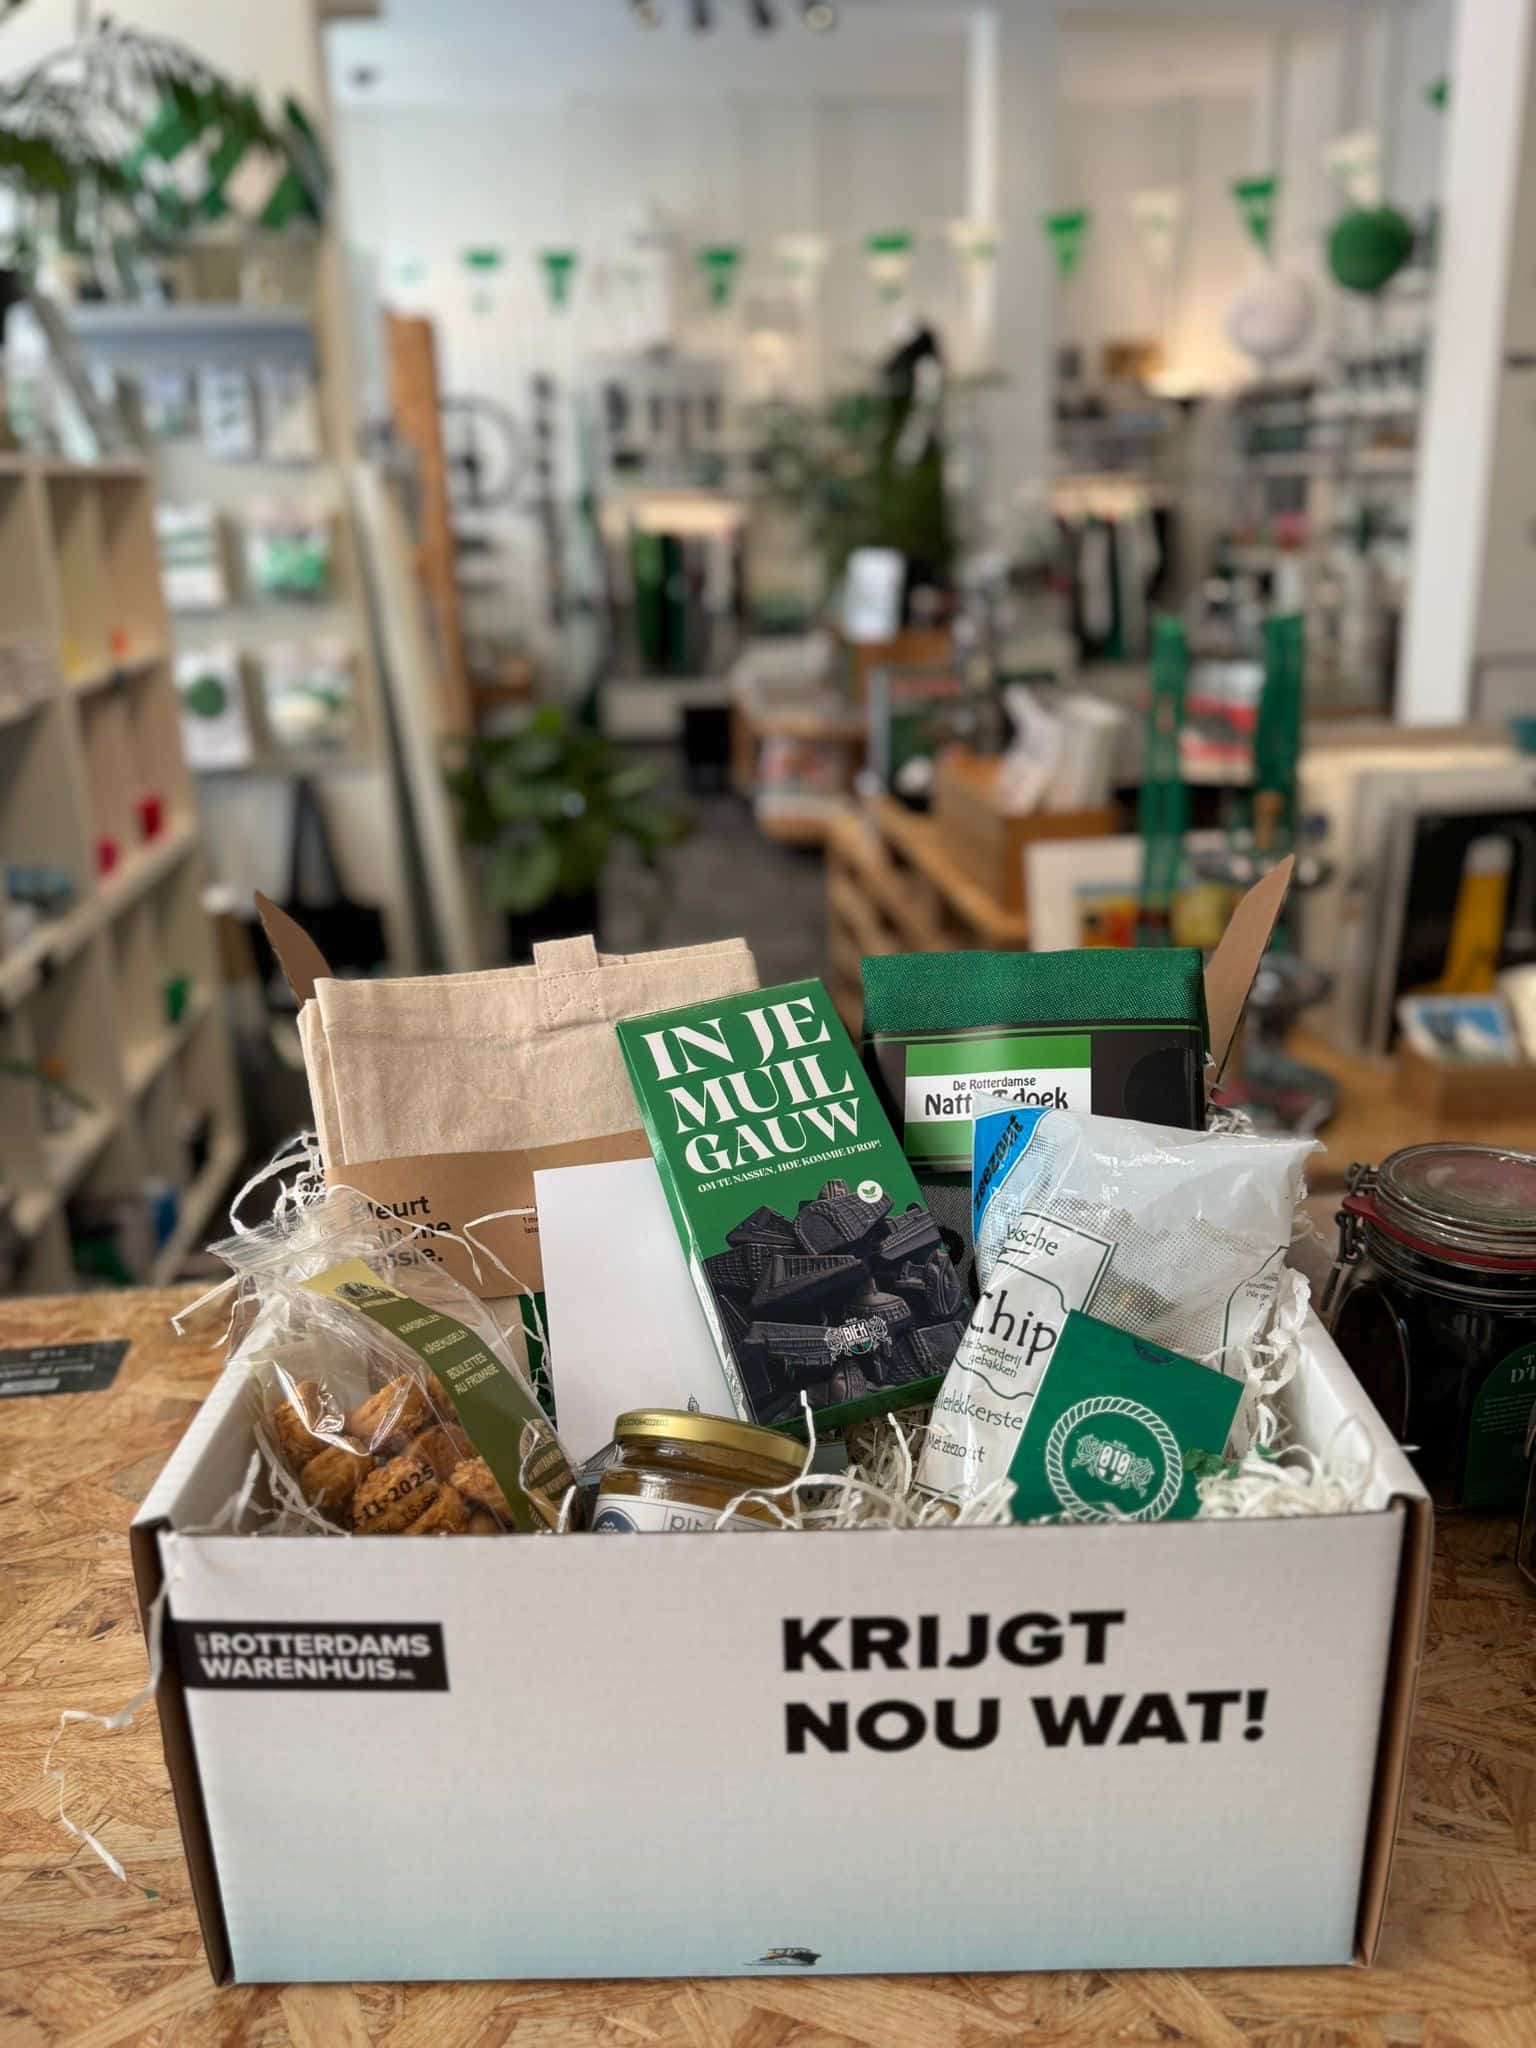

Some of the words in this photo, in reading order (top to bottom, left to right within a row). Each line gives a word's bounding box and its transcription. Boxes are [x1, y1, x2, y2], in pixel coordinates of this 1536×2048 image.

[640, 1018, 734, 1081] IN
[740, 997, 832, 1066] JE
[664, 1054, 855, 1134] MUIL
[953, 1080, 966, 1091] De
[969, 1077, 1036, 1090] Rotterdamse
[685, 1098, 860, 1174] GAUW
[697, 1180, 717, 1193] OM
[717, 1176, 732, 1188] TE
[733, 1166, 777, 1184] NASSEN,
[778, 1160, 801, 1173] HOE
[802, 1148, 847, 1167] KOMMIE
[970, 1290, 1057, 1367] Chip
[446, 1352, 488, 1381] BOULETTES
[207, 1632, 432, 1657] ROTTERDAMS
[782, 1609, 1126, 1672] KRIJGT
[785, 1697, 1001, 1754] NOU
[1030, 1688, 1268, 1748] WAT!
